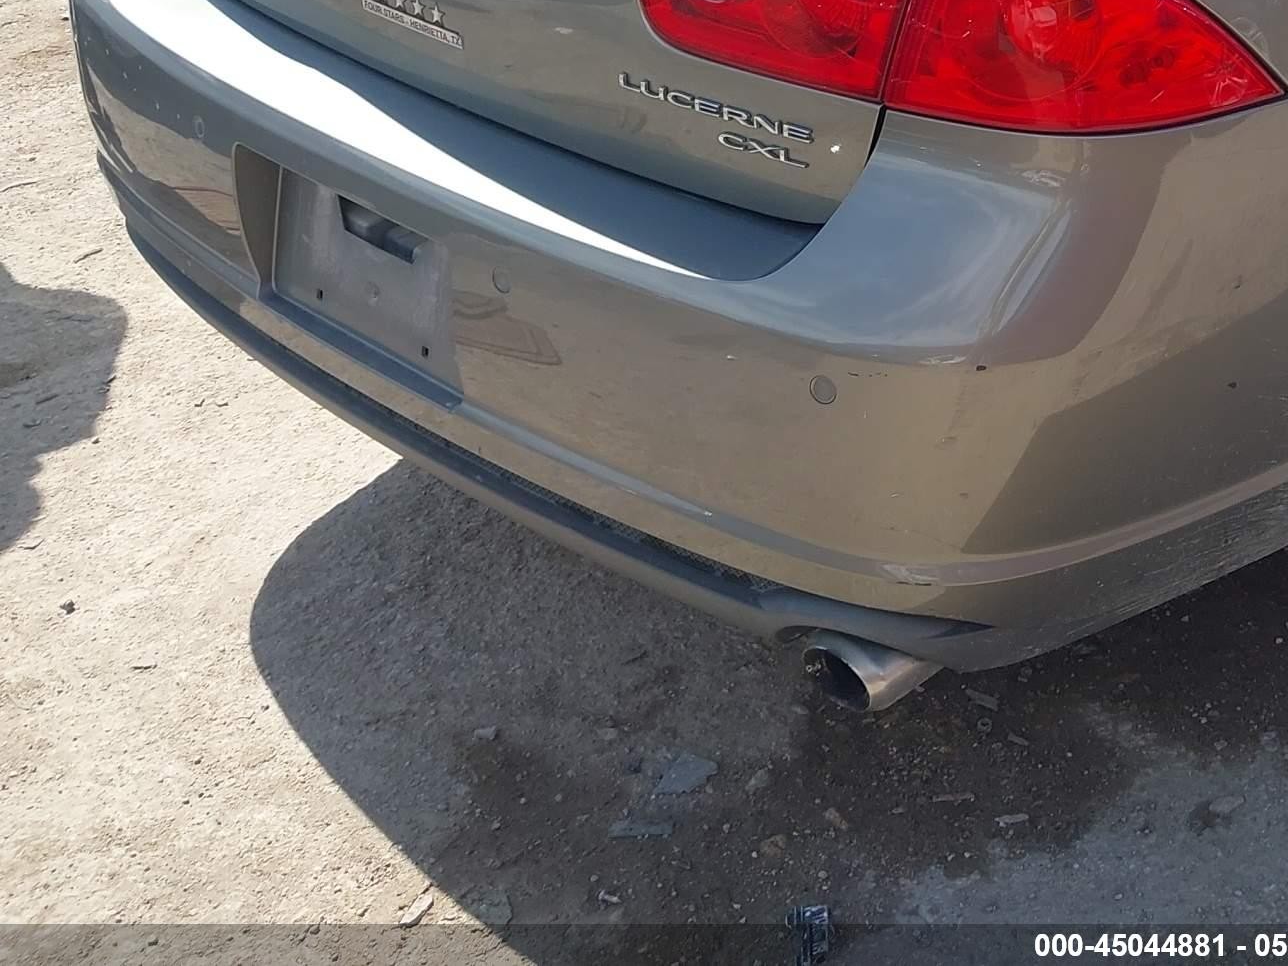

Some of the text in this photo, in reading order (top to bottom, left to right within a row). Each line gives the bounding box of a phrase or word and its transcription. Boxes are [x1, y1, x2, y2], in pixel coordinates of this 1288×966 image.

[363, 0, 382, 14] FOUR
[617, 71, 815, 144] LUCERNE
[717, 131, 810, 169] CXL
